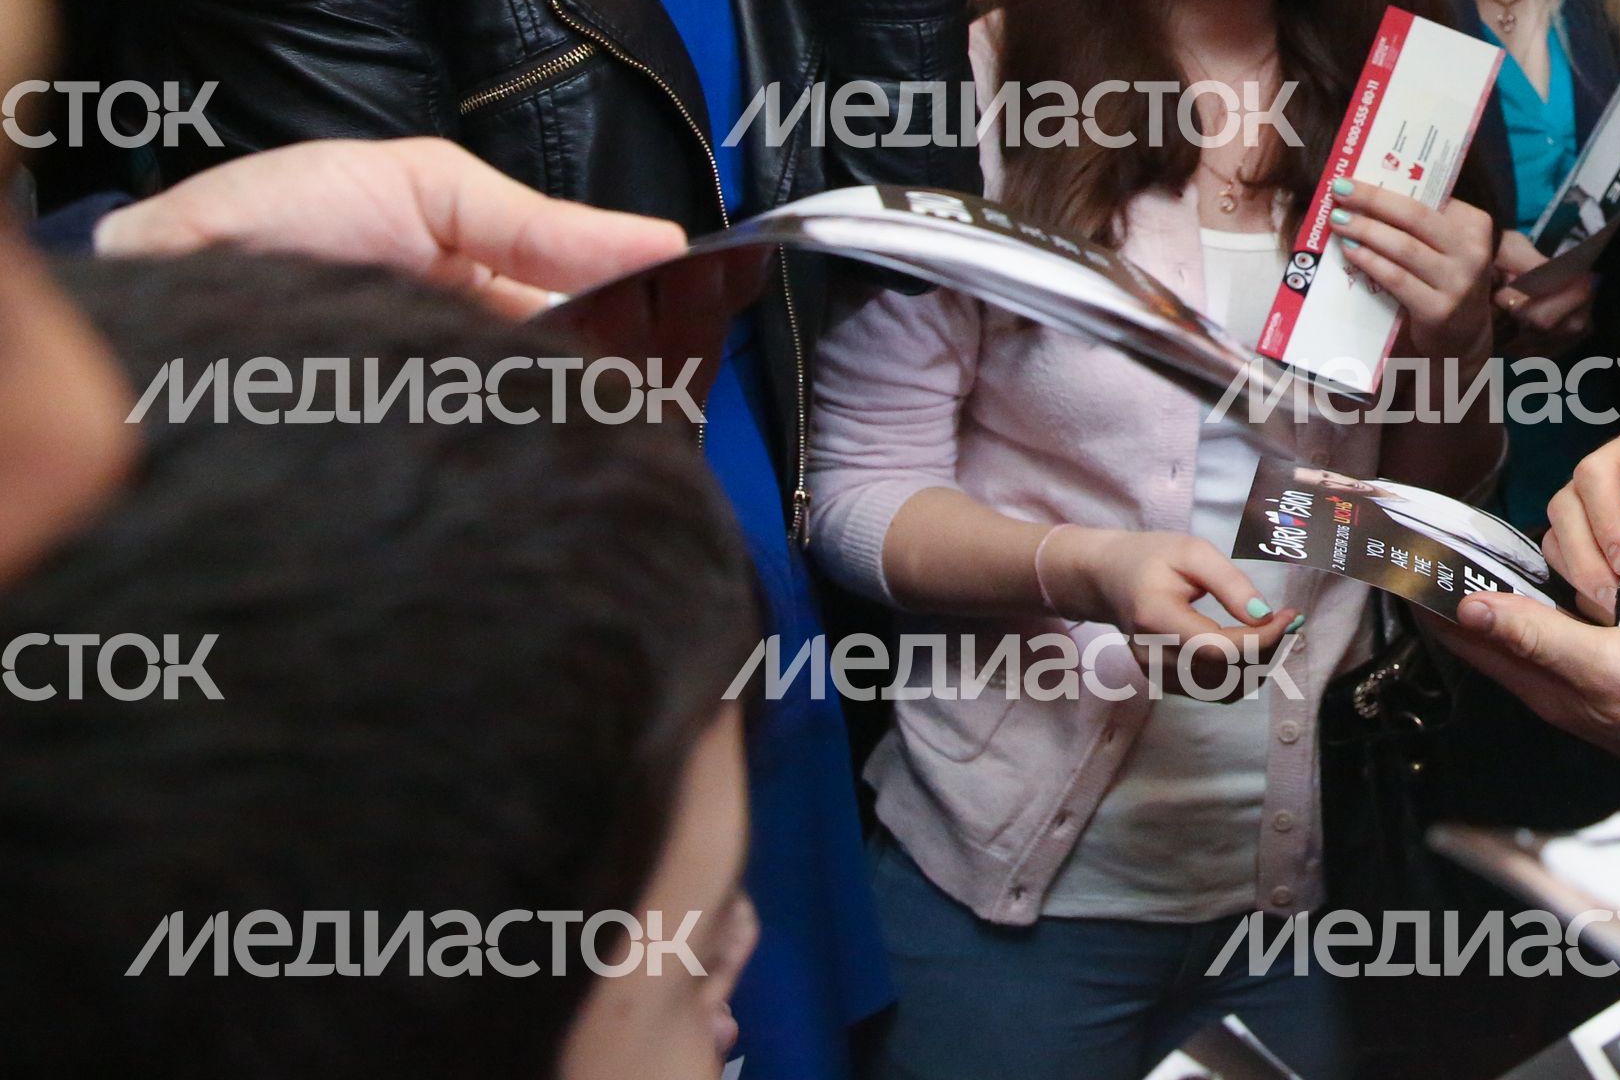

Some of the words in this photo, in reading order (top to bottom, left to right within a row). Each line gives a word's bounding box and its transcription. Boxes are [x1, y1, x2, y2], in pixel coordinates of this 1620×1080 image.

[1336, 524, 1351, 540] 2016
[1332, 539, 1349, 564] АПРЕЛЯ
[1366, 537, 1386, 558] YOU
[1390, 546, 1409, 569] ARE
[1331, 563, 1345, 571] 2
[1414, 555, 1432, 577] THE
[1437, 561, 1454, 592] ONLY
